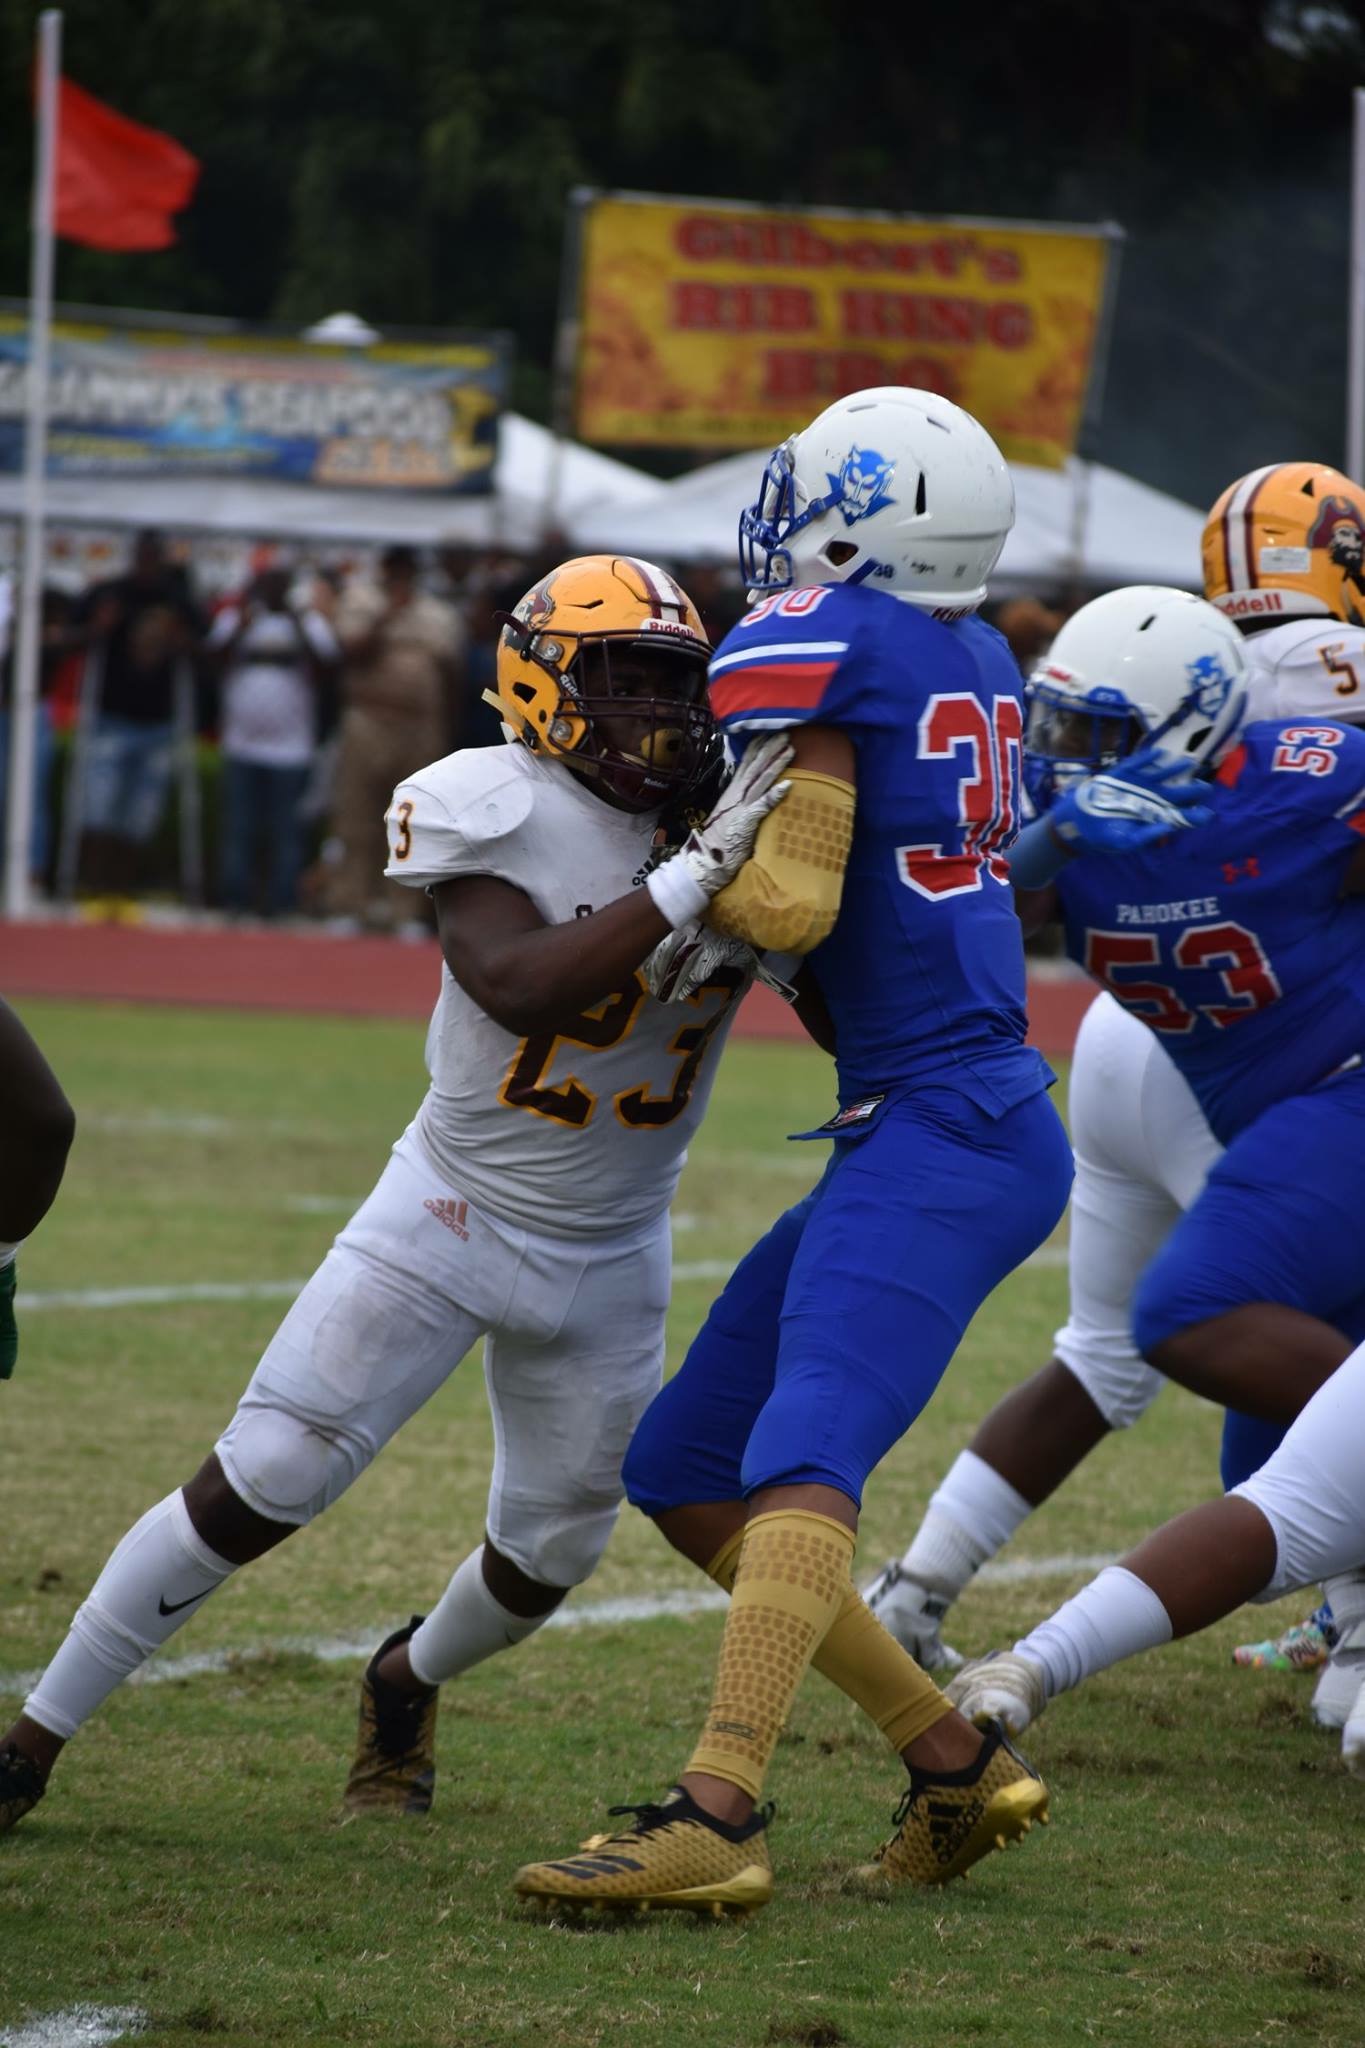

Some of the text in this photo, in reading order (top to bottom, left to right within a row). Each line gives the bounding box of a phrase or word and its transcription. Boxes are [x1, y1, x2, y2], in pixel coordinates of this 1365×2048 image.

[671, 212, 1024, 285] Gilbert's
[668, 281, 1034, 350] RIB KING
[1214, 593, 1282, 616] ddell
[1272, 727, 1346, 778] 53
[1117, 897, 1221, 924] PAHOKEE
[1085, 921, 1282, 1034] 53
[497, 964, 747, 1129] 23
[423, 1199, 470, 1242] adidas
